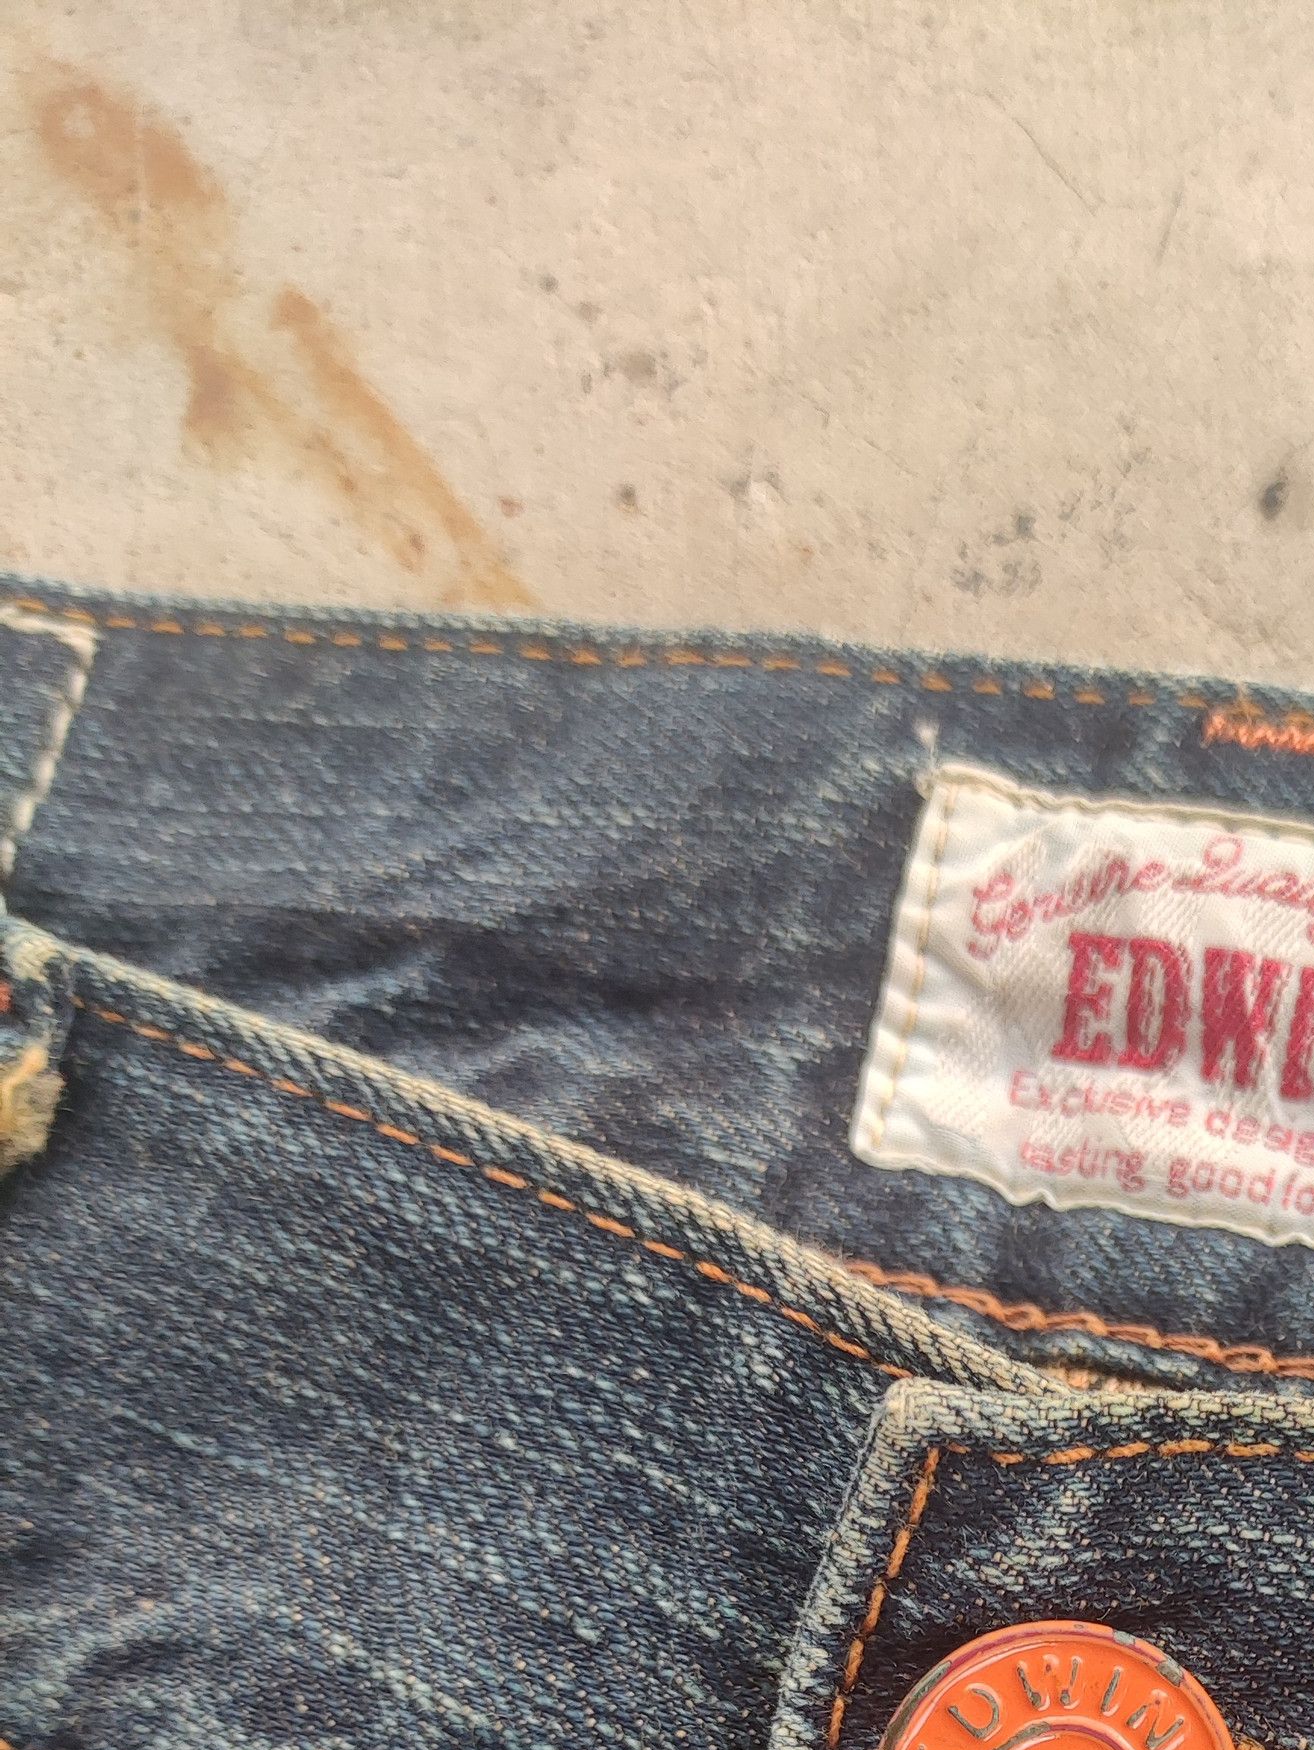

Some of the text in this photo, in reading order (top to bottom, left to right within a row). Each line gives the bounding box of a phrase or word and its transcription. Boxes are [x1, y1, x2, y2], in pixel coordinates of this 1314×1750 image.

[967, 856, 1170, 961] Genuine
[1009, 1069, 1193, 1128] Exclusive
[1165, 1156, 1278, 1207] good
